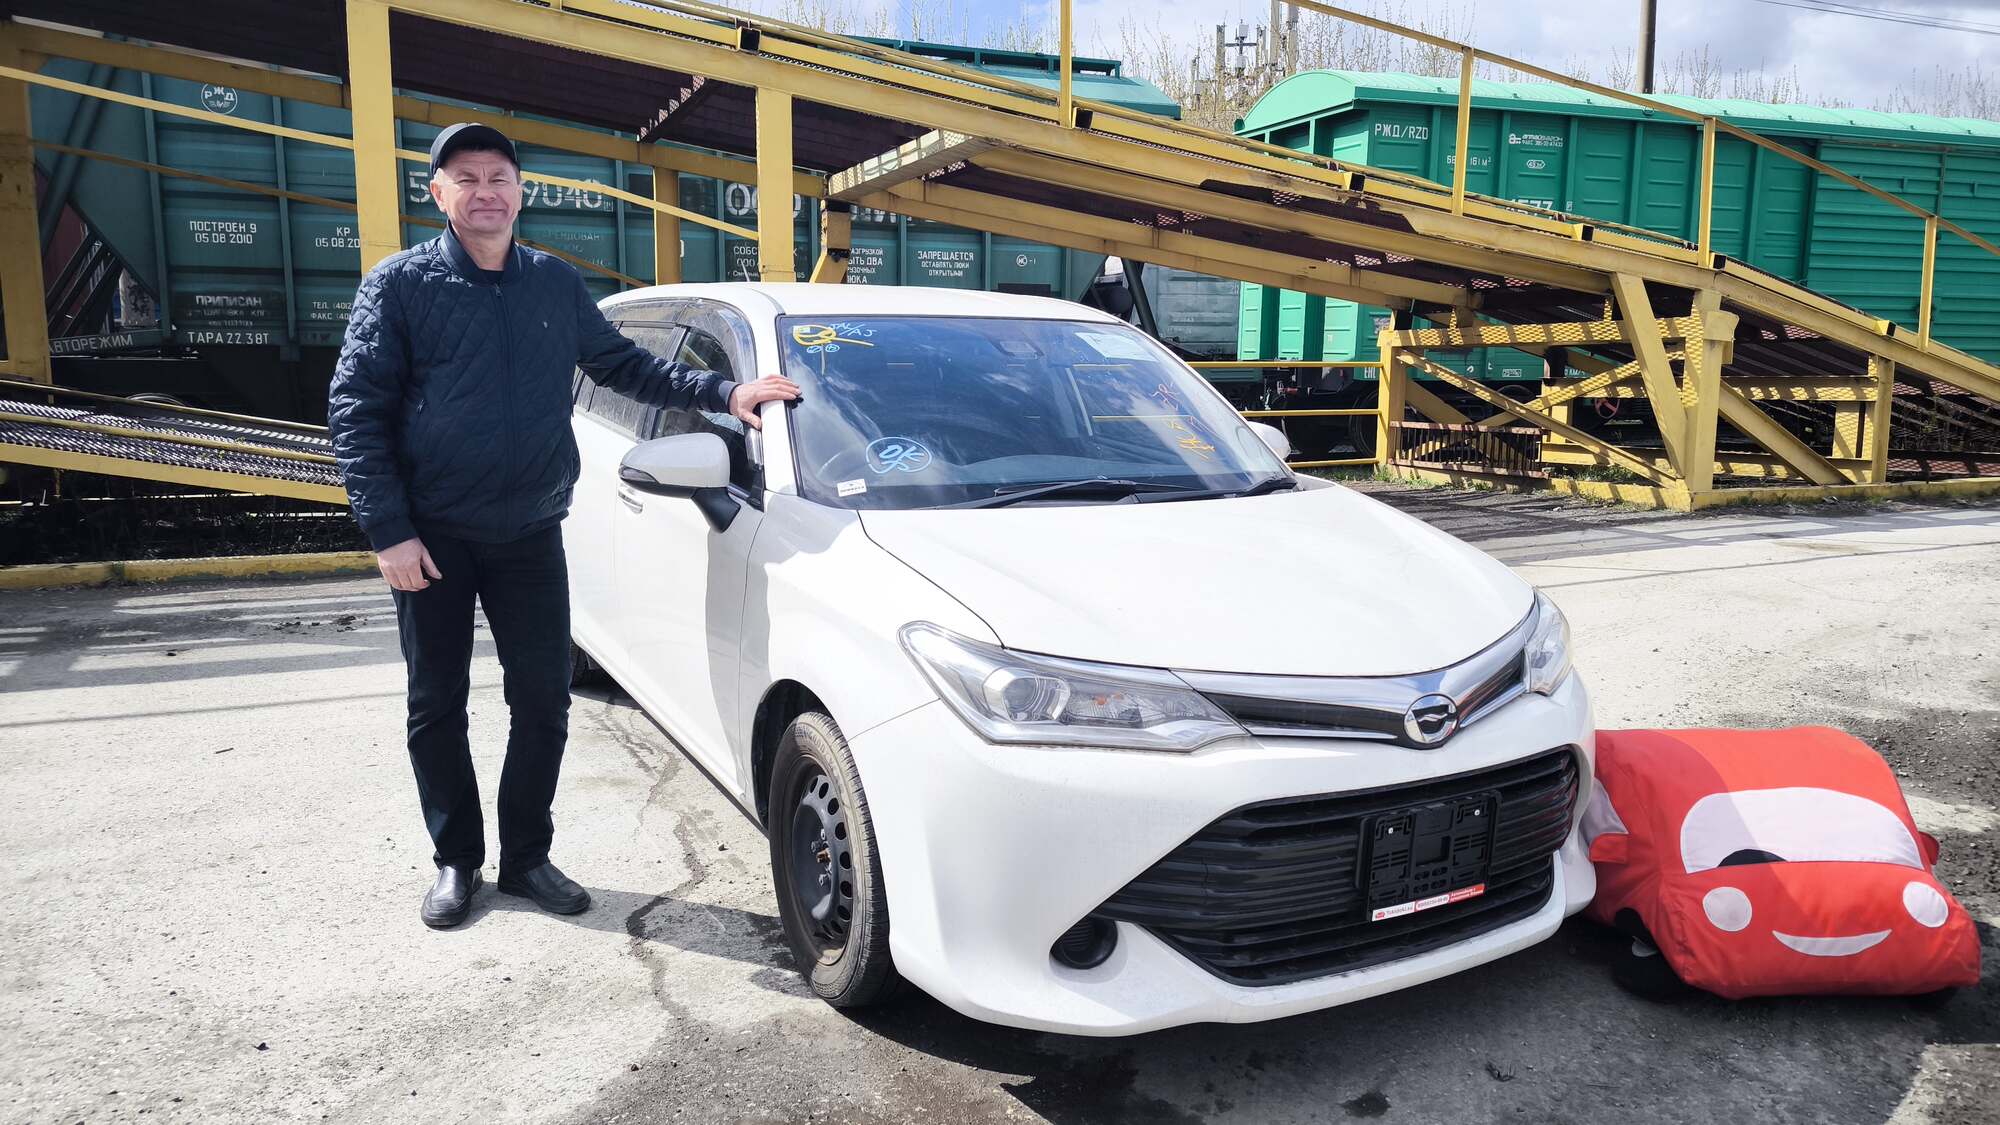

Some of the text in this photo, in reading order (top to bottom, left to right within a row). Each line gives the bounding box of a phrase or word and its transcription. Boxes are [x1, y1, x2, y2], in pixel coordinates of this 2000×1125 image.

[204, 86, 235, 101] РЖД
[1374, 123, 1429, 140] РЖД/RZD
[189, 220, 257, 233] ПОСТРОЕН 9
[336, 226, 350, 236] КР
[195, 233, 253, 244] 05 08 2010
[315, 238, 360, 248] 05 08 20
[733, 245, 760, 255] СОБС
[849, 247, 883, 256] АЗГРУЗКОЙ
[917, 250, 974, 261] ЗАПРЕЩАЕТСЯ
[867, 257, 883, 266] ДВА
[921, 261, 952, 269] ОСТАВЛЯТЬ
[928, 269, 963, 277] ОТКРЫТЫМИ
[196, 295, 262, 307] ПРИПИСАН
[310, 313, 332, 321] ФАКС
[187, 331, 224, 344] ТАРА
